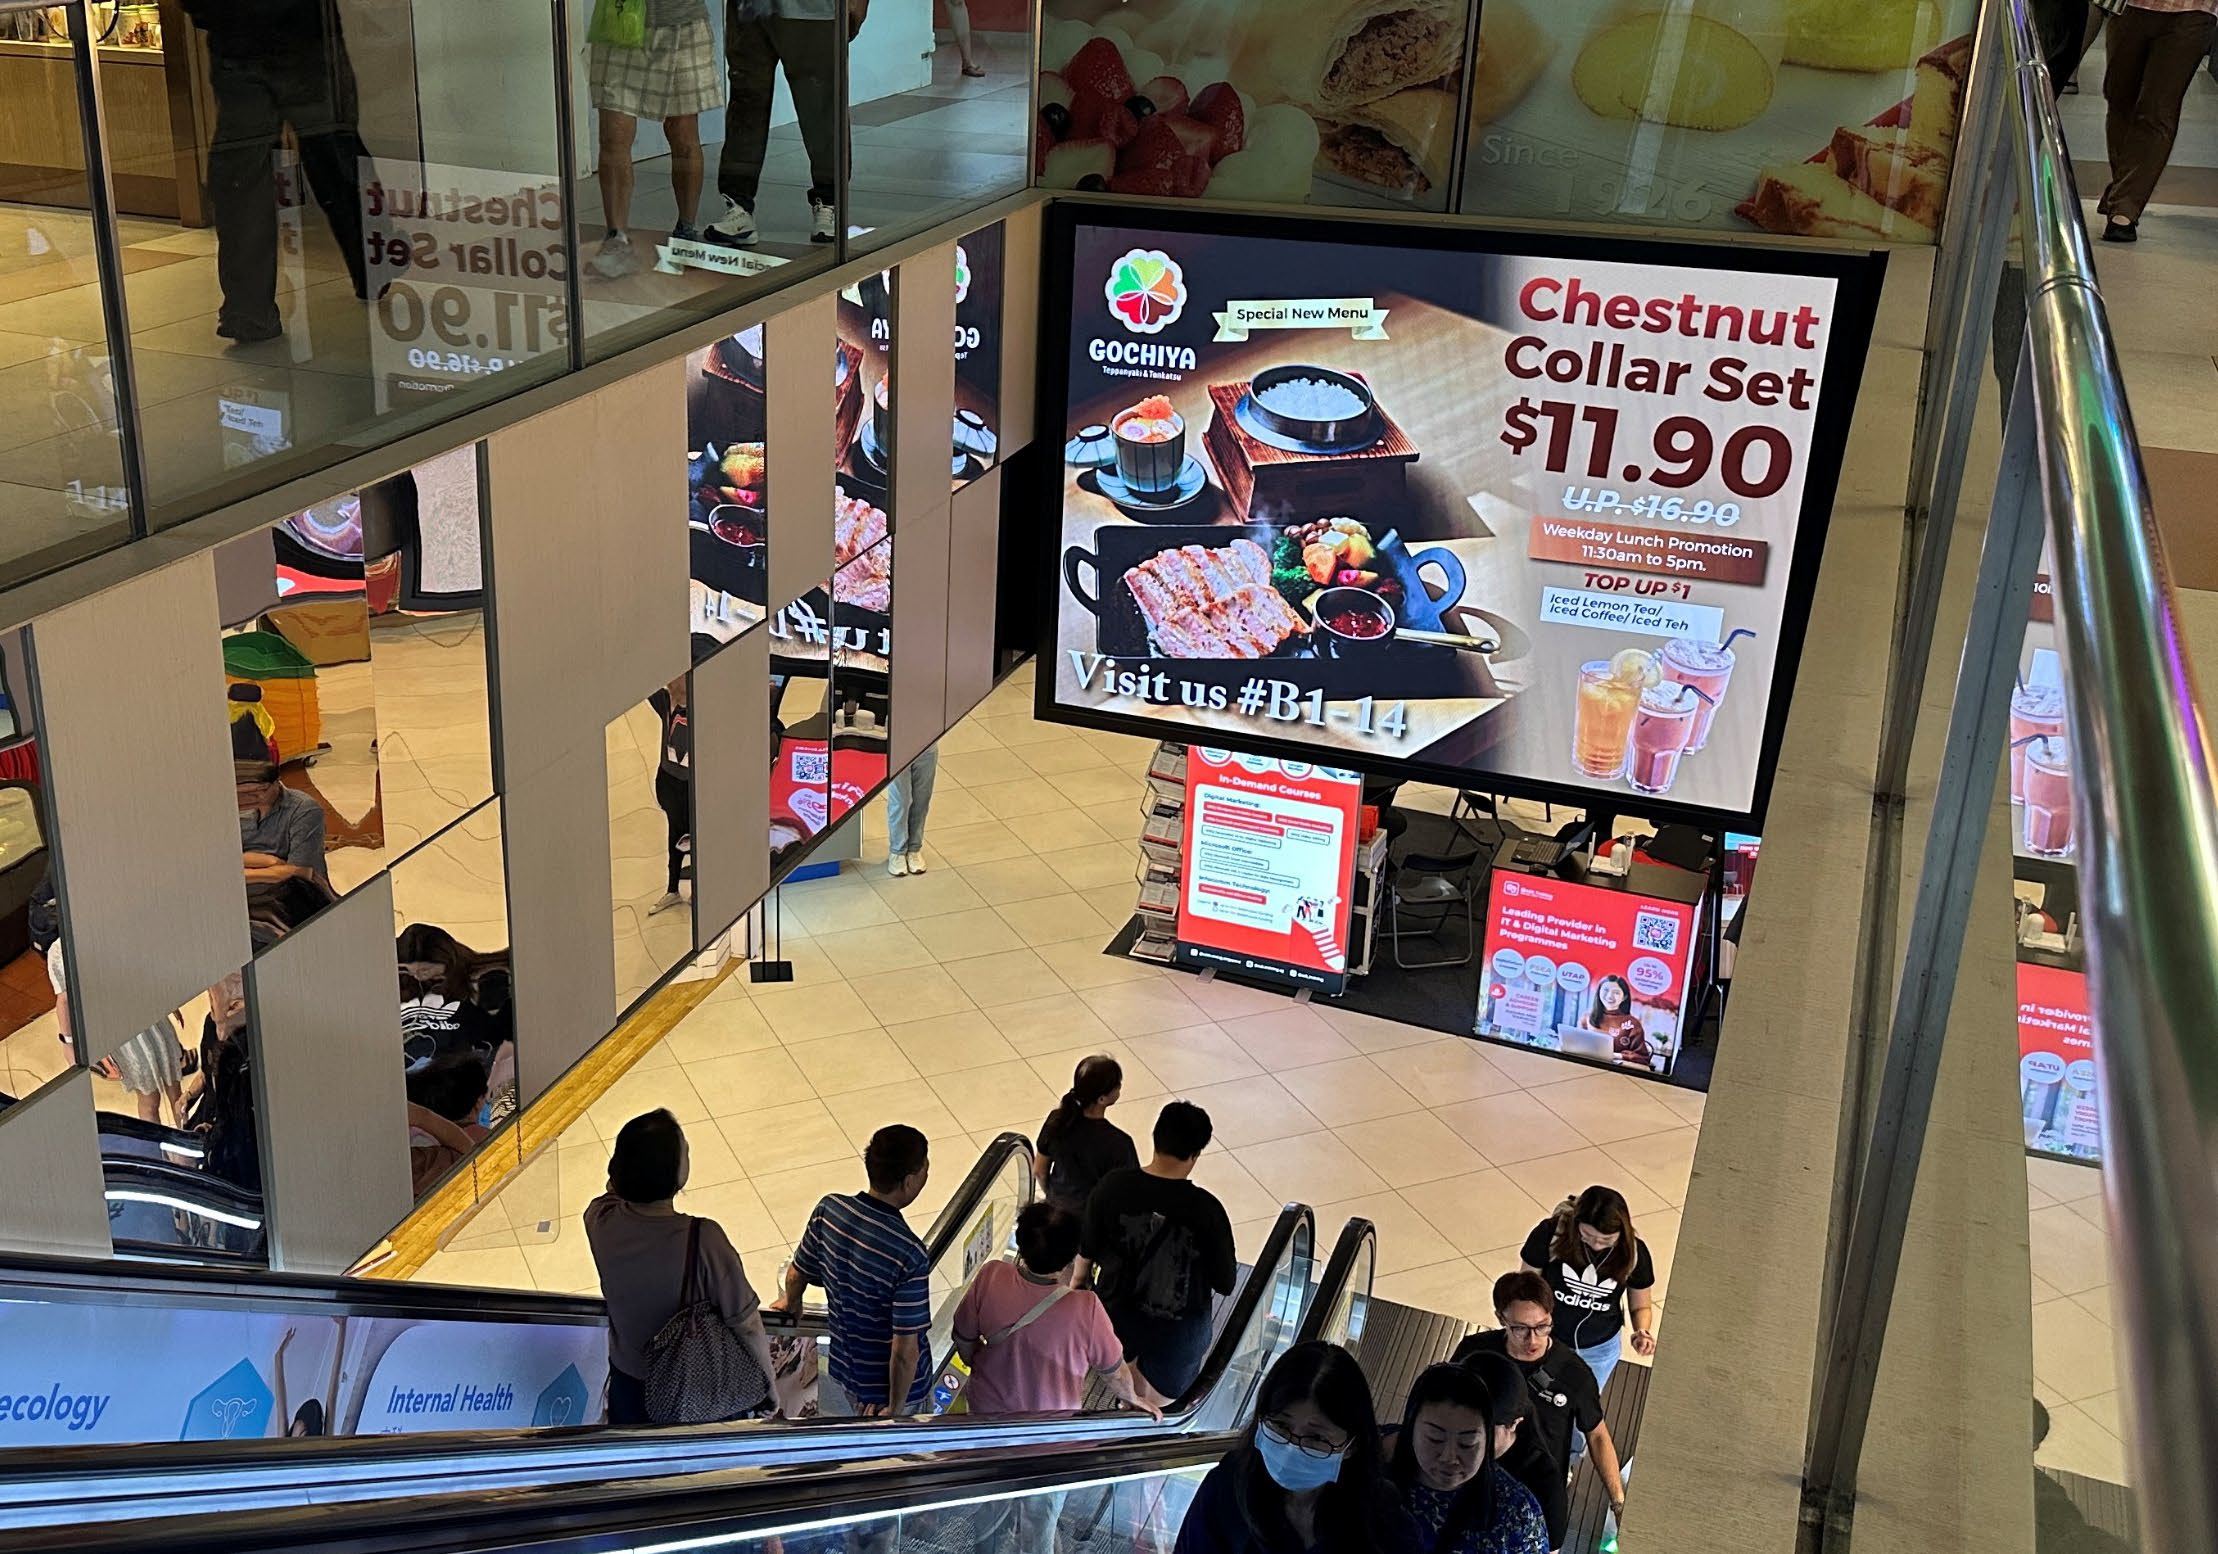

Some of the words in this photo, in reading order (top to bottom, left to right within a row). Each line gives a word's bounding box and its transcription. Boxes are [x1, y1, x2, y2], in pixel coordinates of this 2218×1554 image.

[1481, 134, 1581, 169] Since
[1237, 307, 1288, 321] Special
[1291, 307, 1325, 319] New
[1327, 307, 1369, 319] Menu
[1519, 277, 1820, 349] Chestnut
[1089, 338, 1196, 370] GOCHIYA
[1102, 365, 1142, 378] Teppanyaki
[1149, 370, 1182, 381] Tonkatsu
[1504, 335, 1691, 395] Collar
[1703, 357, 1814, 410] Set
[1500, 397, 1792, 498] $11.90
[1562, 486, 1622, 514] U.P.
[1631, 496, 1740, 526] $16.90
[1543, 523, 1612, 544] Weekday
[1616, 532, 1664, 548] Lunch
[1668, 536, 1753, 558] Promotion
[1582, 545, 1642, 563] 11:30am
[1646, 553, 1662, 566] to
[1666, 555, 1706, 572] 5pm.
[1584, 573, 1630, 590] TOP
[1634, 579, 1667, 596] UP
[1672, 582, 1691, 600] $1
[1550, 594, 1579, 606] Iced
[1582, 597, 1629, 613] Lemon
[1633, 602, 1664, 617] Tea/
[1550, 605, 1577, 617] Iced
[1581, 607, 1631, 624] Coffee/
[1631, 614, 1662, 628] Iced
[1665, 618, 1689, 632] Teh
[1066, 649, 1171, 701] Visit
[1180, 680, 1228, 710] us
[1237, 677, 1406, 738] #B1-14
[1219, 773, 1277, 793] In-Demand
[1279, 785, 1321, 800] Courses
[1501, 917, 1511, 927] IT
[1513, 919, 1520, 928] &
[1523, 920, 1559, 937] Digital
[1560, 930, 1617, 949] Marketing
[1502, 906, 1545, 924] Leading
[1547, 916, 1592, 932] Provider
[1595, 924, 1607, 934] in
[1500, 929, 1568, 950] Programmes
[1561, 970, 1585, 981] UTAP
[1636, 966, 1664, 981] 95%
[1554, 1290, 1611, 1312] adidas
[0, 1382, 110, 1431] ecology
[387, 1383, 460, 1413] Internal
[460, 1382, 514, 1412] Health
